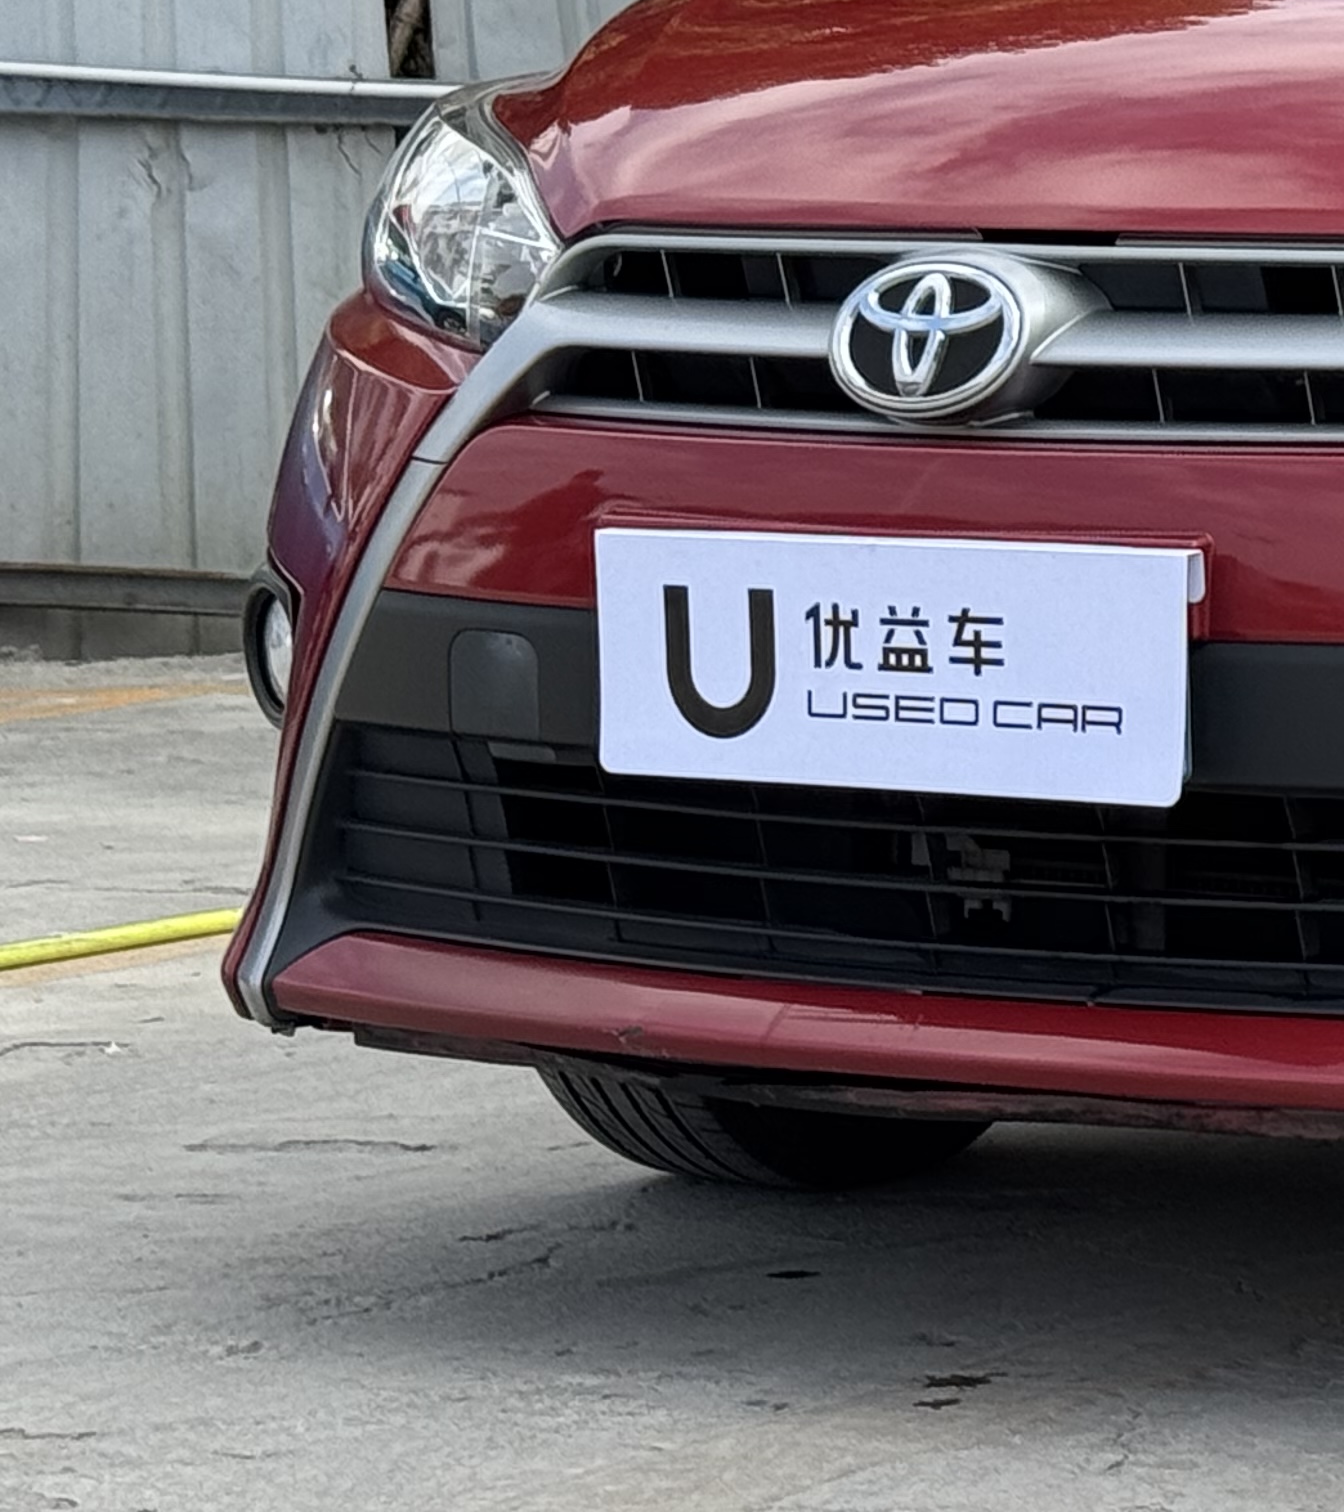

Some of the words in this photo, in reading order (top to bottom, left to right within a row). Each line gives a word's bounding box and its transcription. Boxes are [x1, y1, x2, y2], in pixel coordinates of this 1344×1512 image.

[663, 585, 775, 739] U
[805, 603, 1004, 676] 优益车
[808, 690, 979, 726] USED
[993, 700, 1122, 735] CAR
